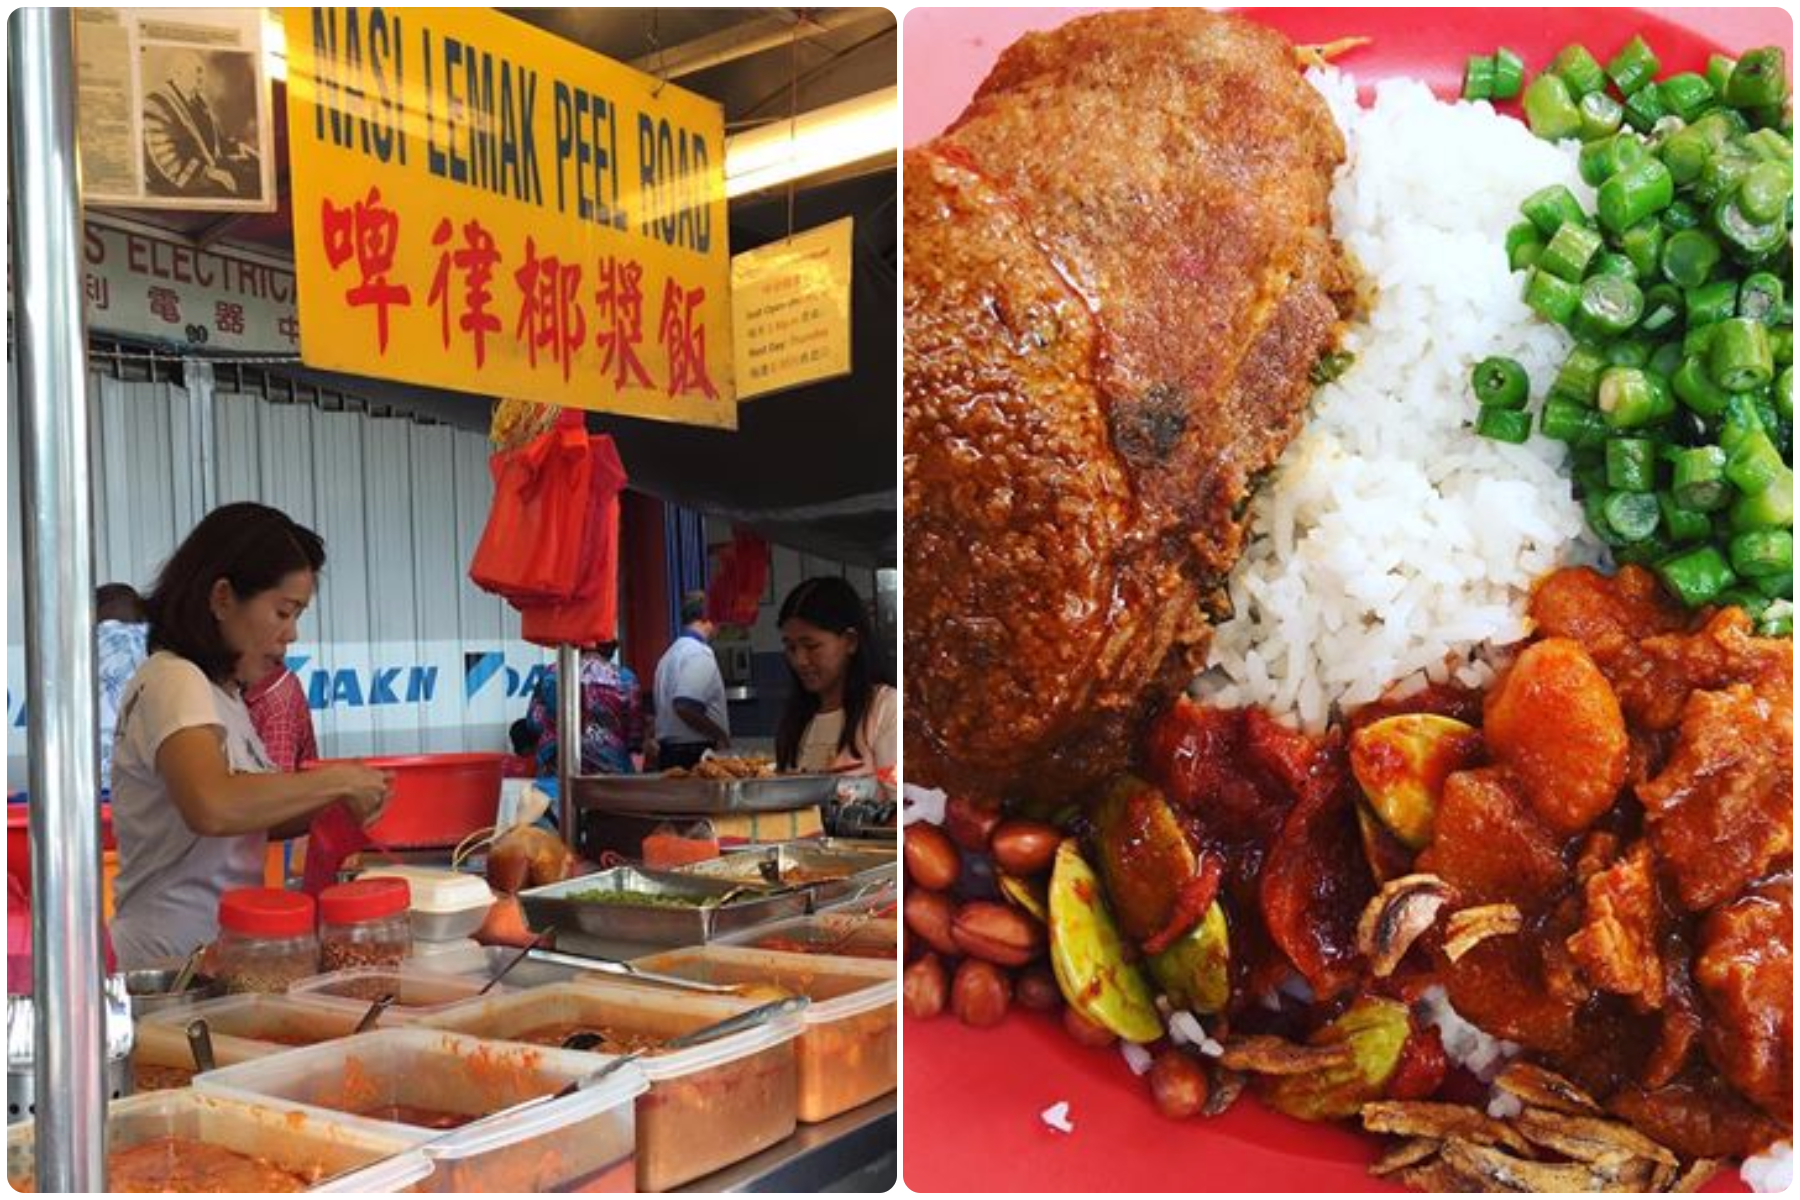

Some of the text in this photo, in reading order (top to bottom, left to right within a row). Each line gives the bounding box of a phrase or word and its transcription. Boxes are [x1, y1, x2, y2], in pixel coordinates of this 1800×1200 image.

[313, 7, 406, 165] NASI
[423, 28, 542, 207] LEMAK
[554, 79, 628, 232] PEEL
[638, 111, 711, 254] ROAD
